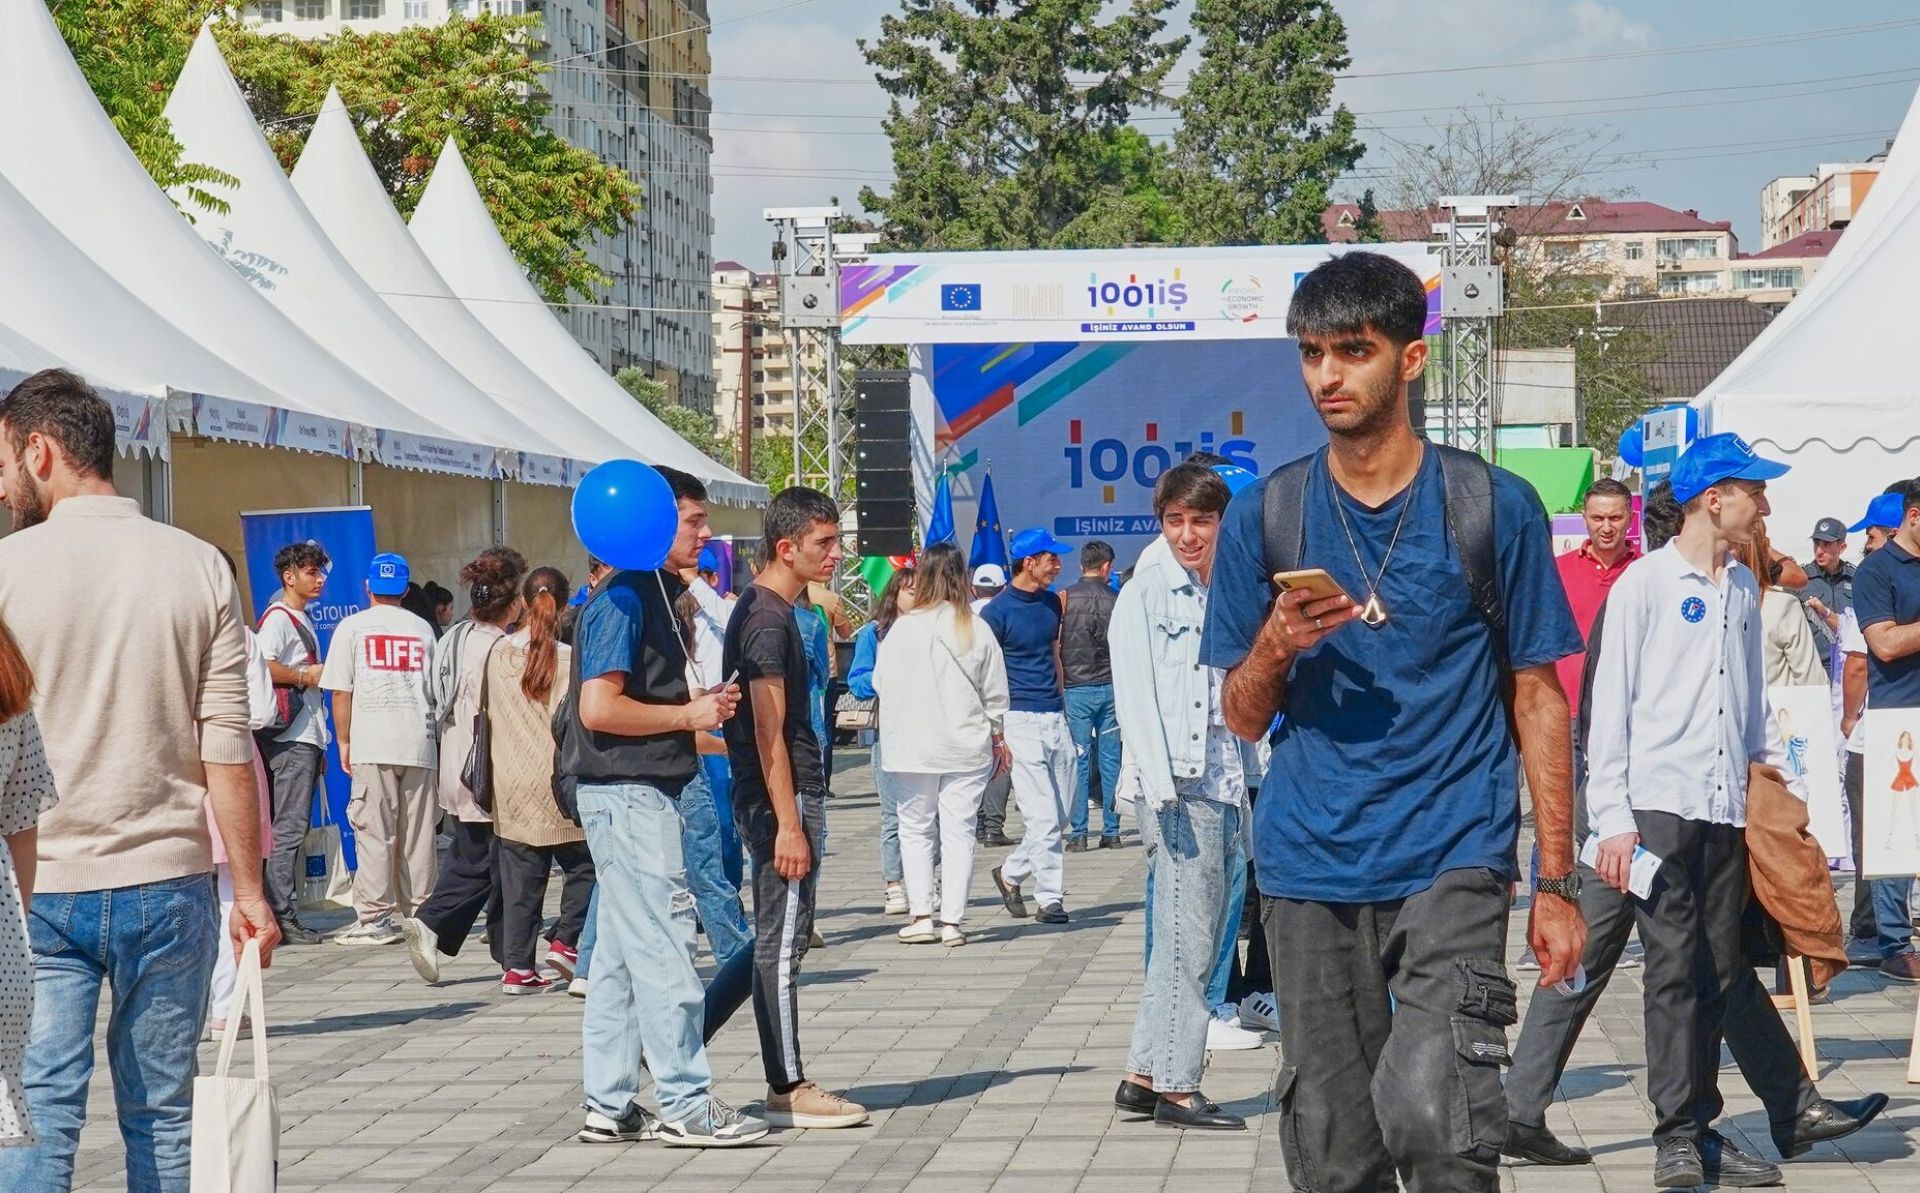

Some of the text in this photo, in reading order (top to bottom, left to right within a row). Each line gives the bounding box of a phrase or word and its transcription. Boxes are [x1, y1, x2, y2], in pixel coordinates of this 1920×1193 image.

[1121, 323, 1152, 331] AVAND
[1156, 323, 1186, 331] OLSUN
[1075, 519, 1161, 535] İŞİNİZ AVA
[368, 639, 423, 668] LIFE
